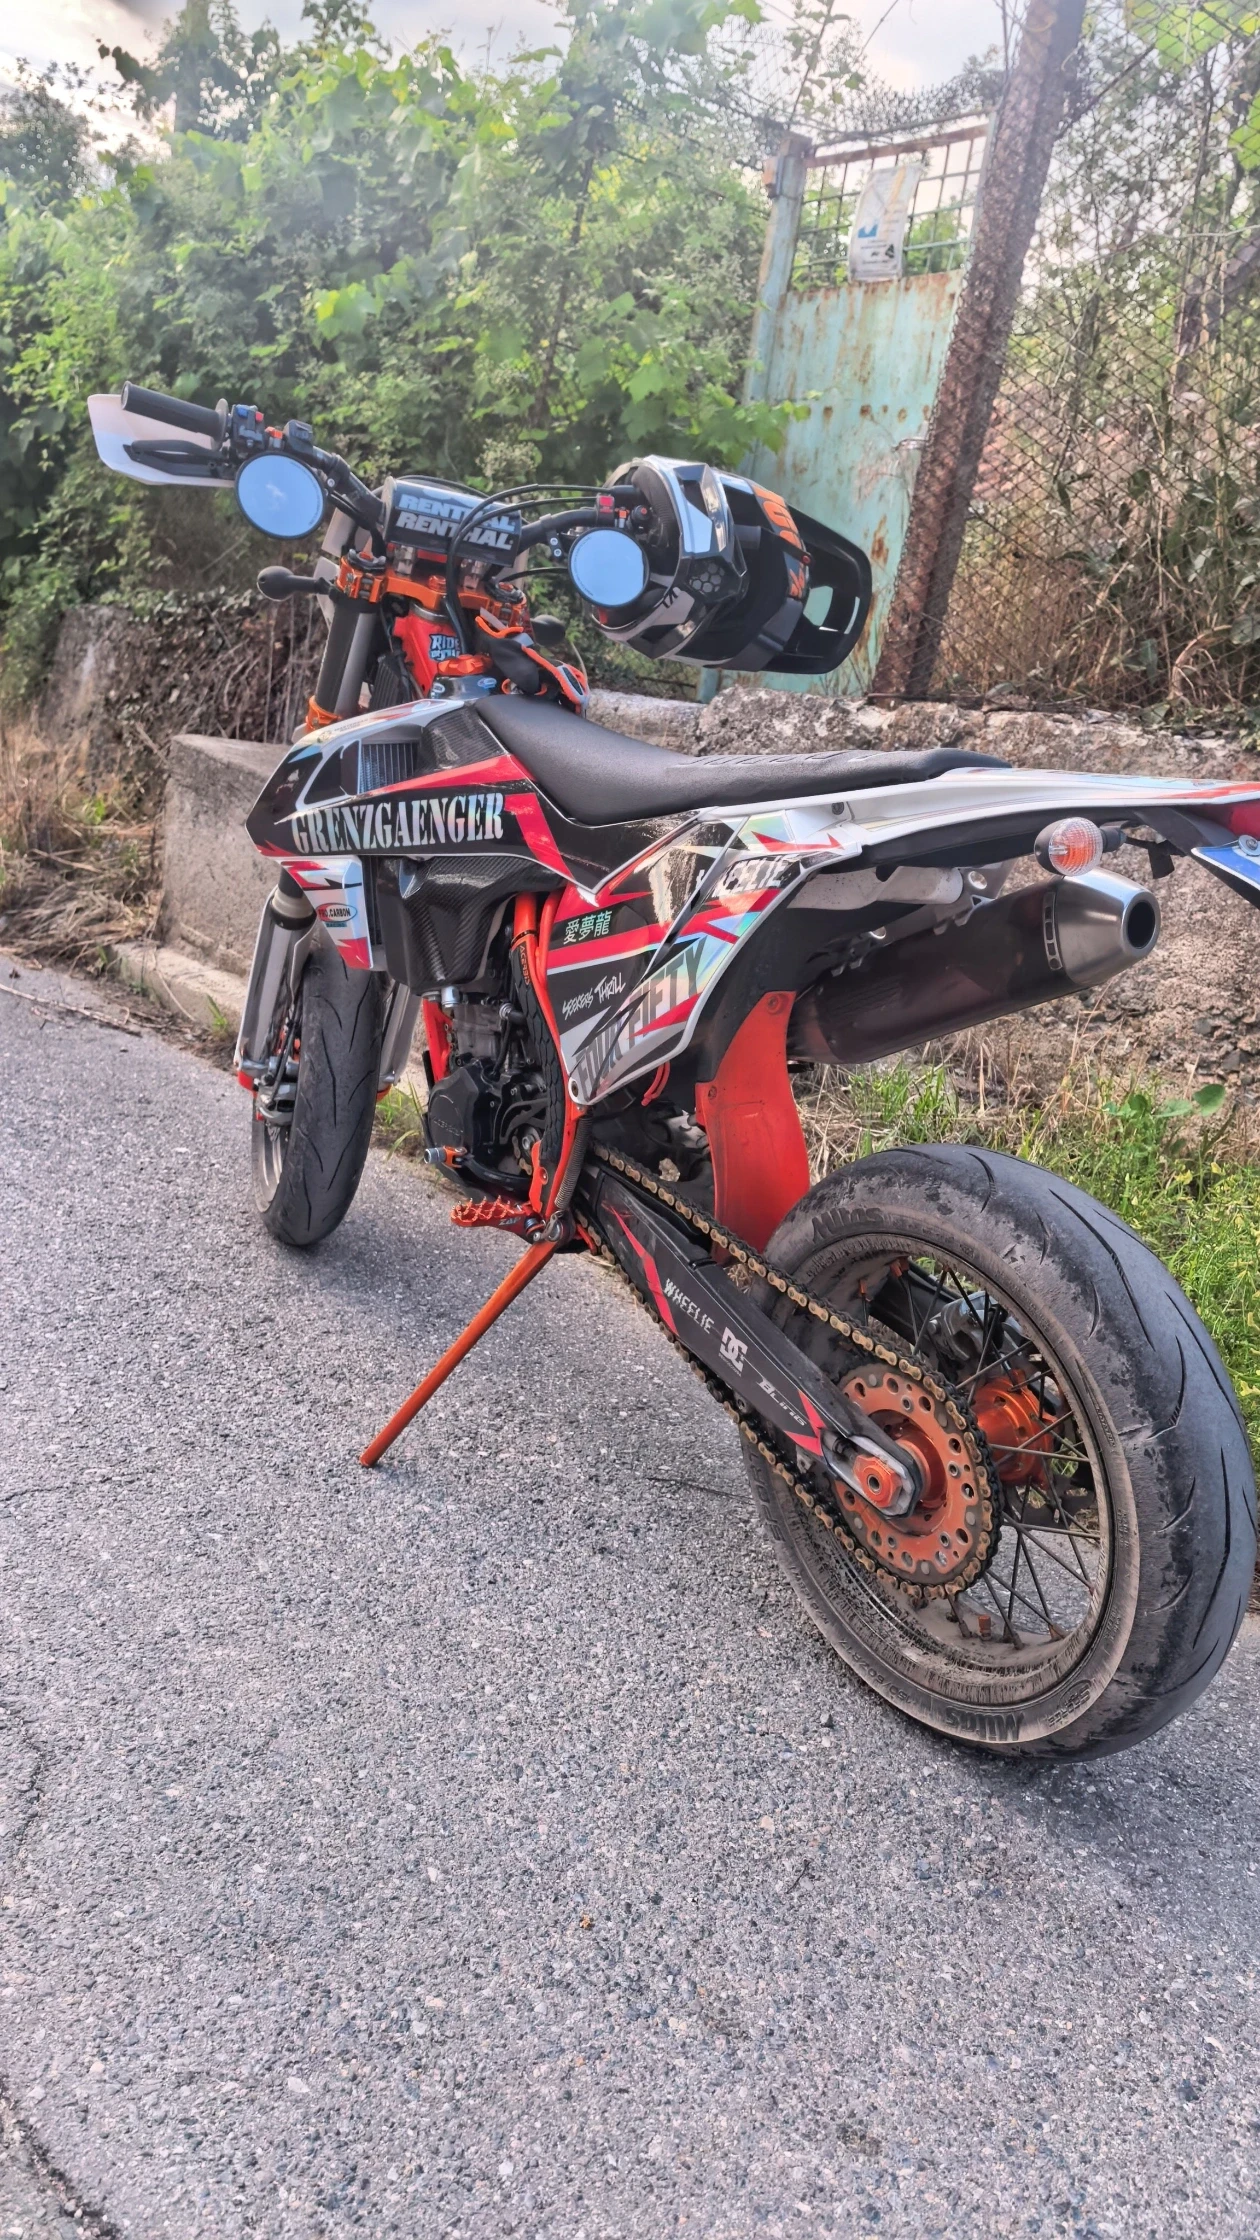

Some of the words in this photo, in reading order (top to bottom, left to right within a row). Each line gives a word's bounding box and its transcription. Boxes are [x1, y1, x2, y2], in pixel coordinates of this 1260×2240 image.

[399, 494, 515, 532] RENTAL
[430, 635, 460, 650] RIDE
[291, 791, 504, 855] GRENZGAENGER
[563, 910, 612, 945] 愛夢龍
[562, 986, 594, 1020] SEEKERS
[594, 972, 626, 1004] THRILL
[664, 1278, 714, 1334] WHEELIE
[720, 1327, 748, 1372] DC
